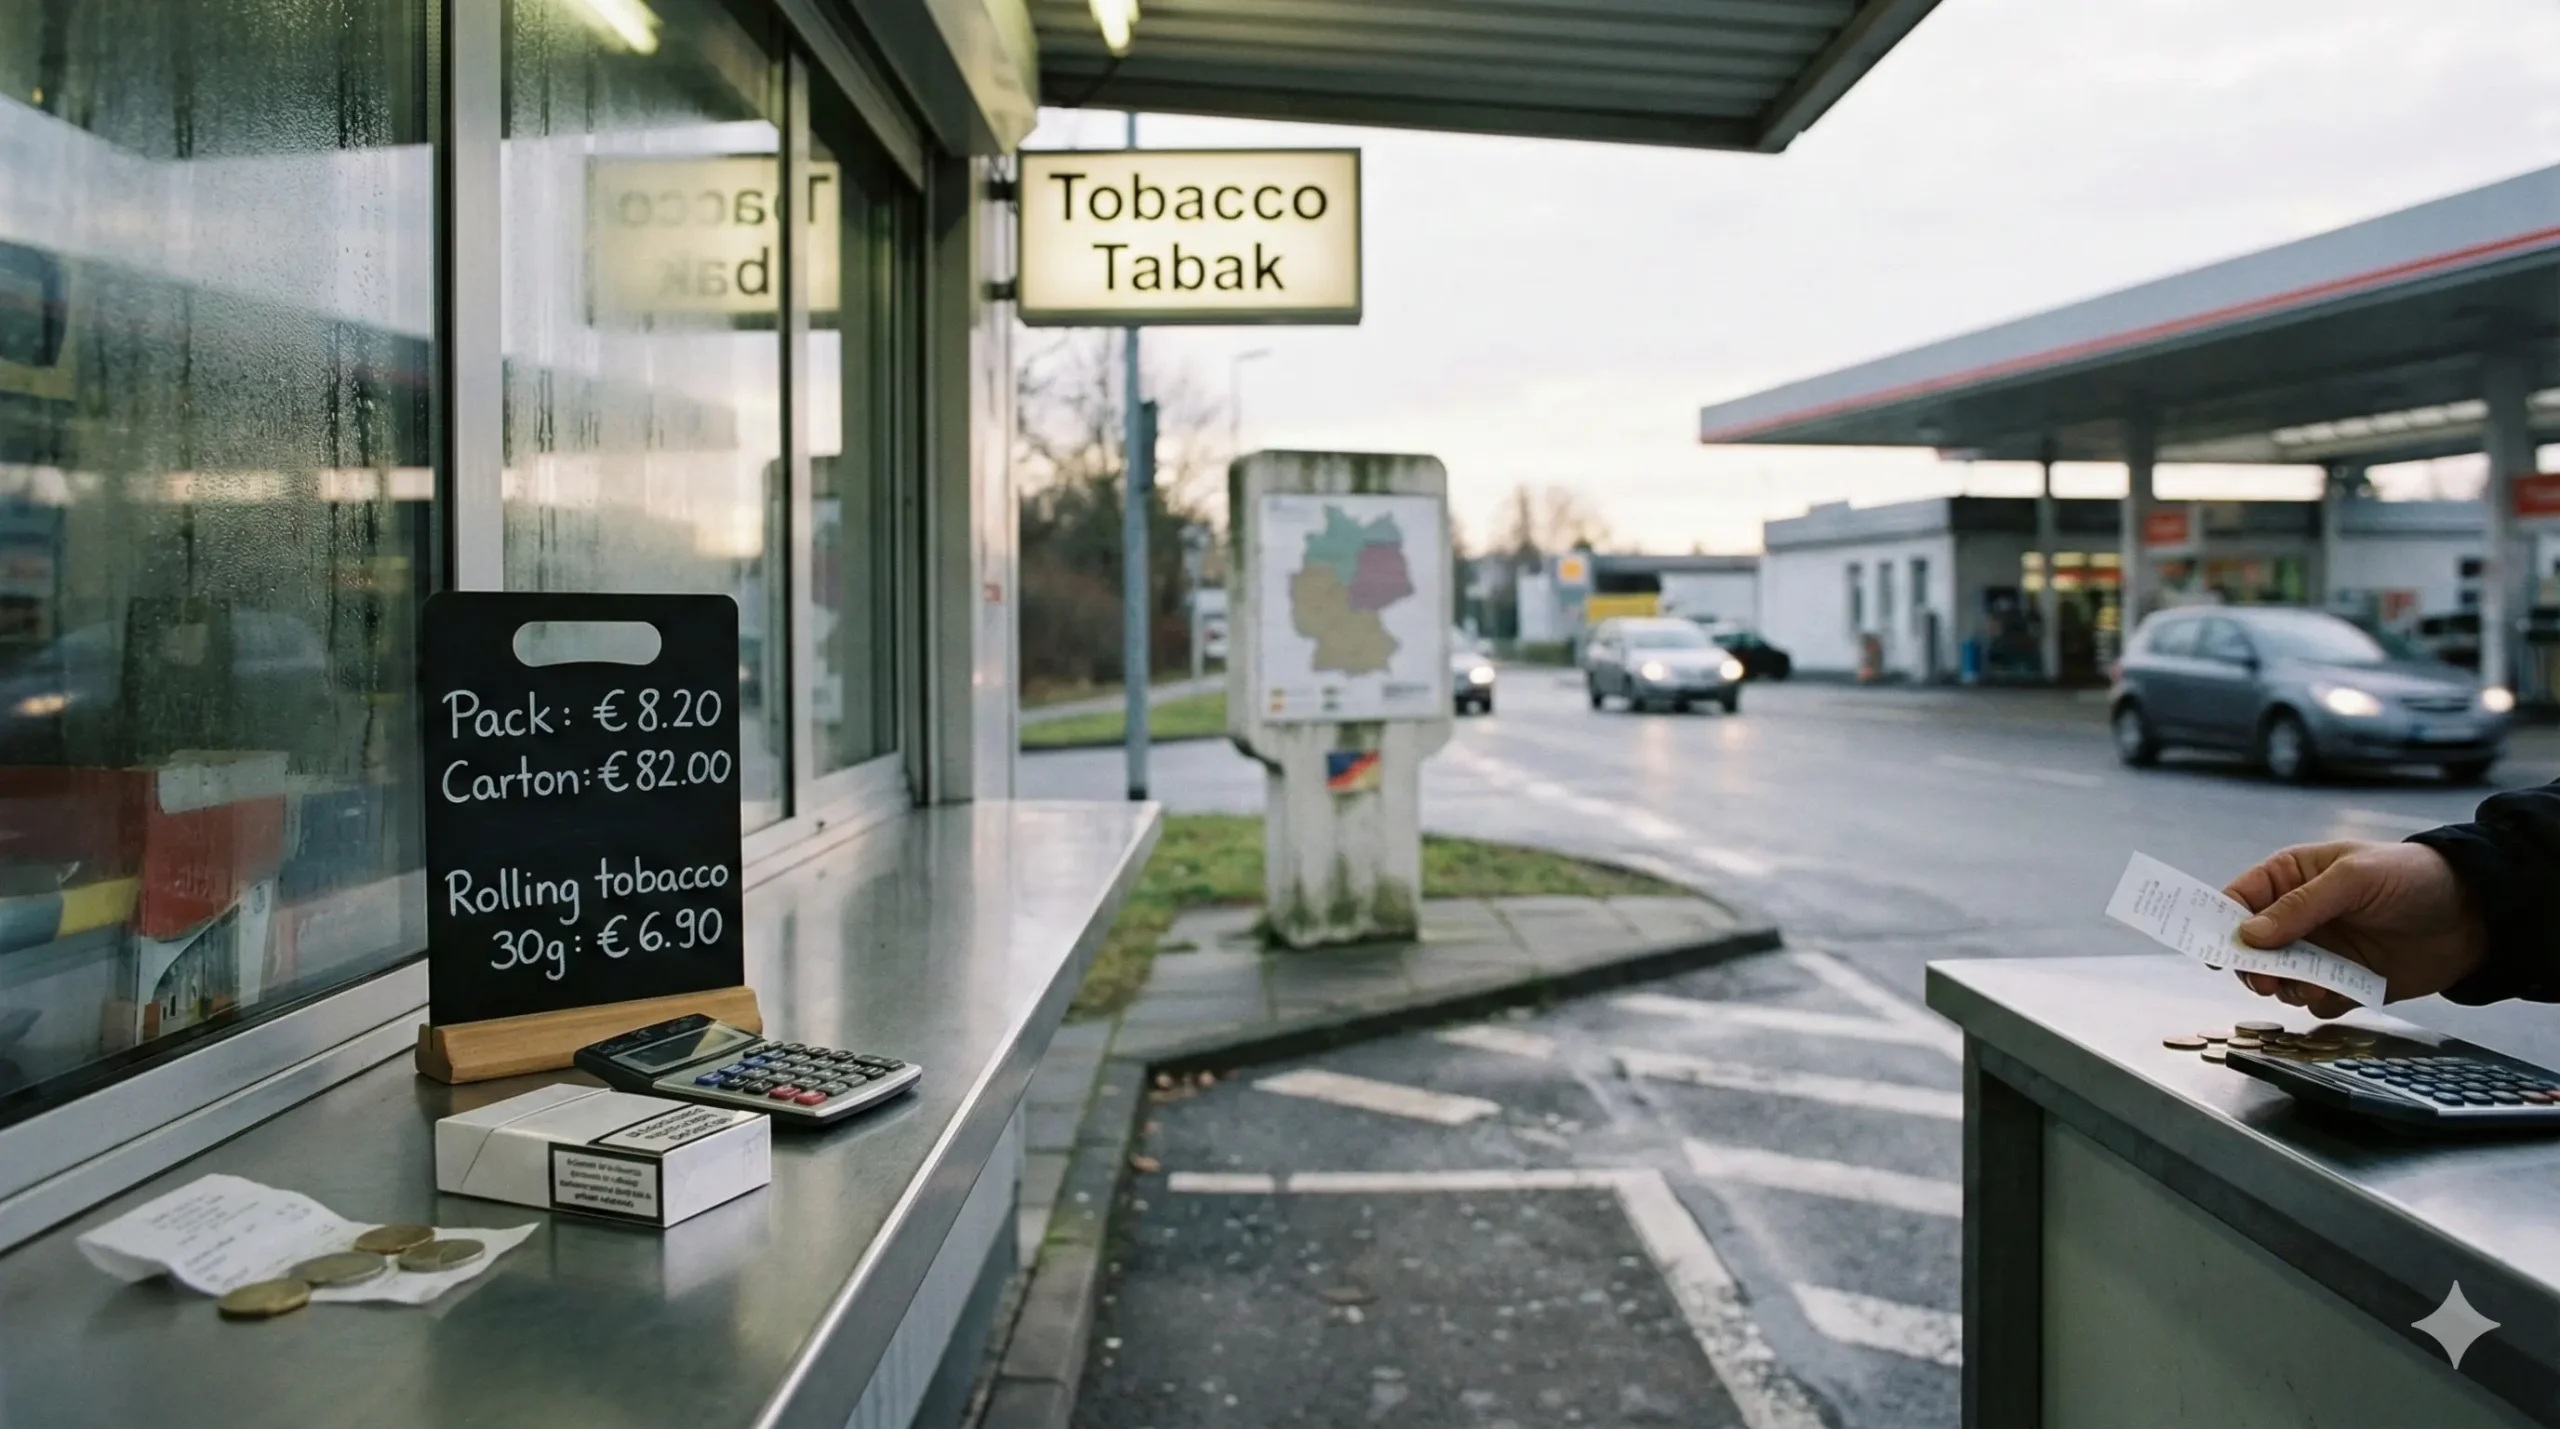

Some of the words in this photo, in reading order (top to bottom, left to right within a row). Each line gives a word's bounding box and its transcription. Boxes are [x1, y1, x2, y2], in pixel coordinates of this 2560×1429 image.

[1048, 172, 1329, 221] Tobacco
[1092, 243, 1286, 291] Tabak
[442, 689, 571, 739] Pack:
[442, 755, 590, 803] Carton:
[444, 867, 580, 926] Rolling
[593, 855, 729, 899] tobacco
[490, 928, 582, 981] 30g:
